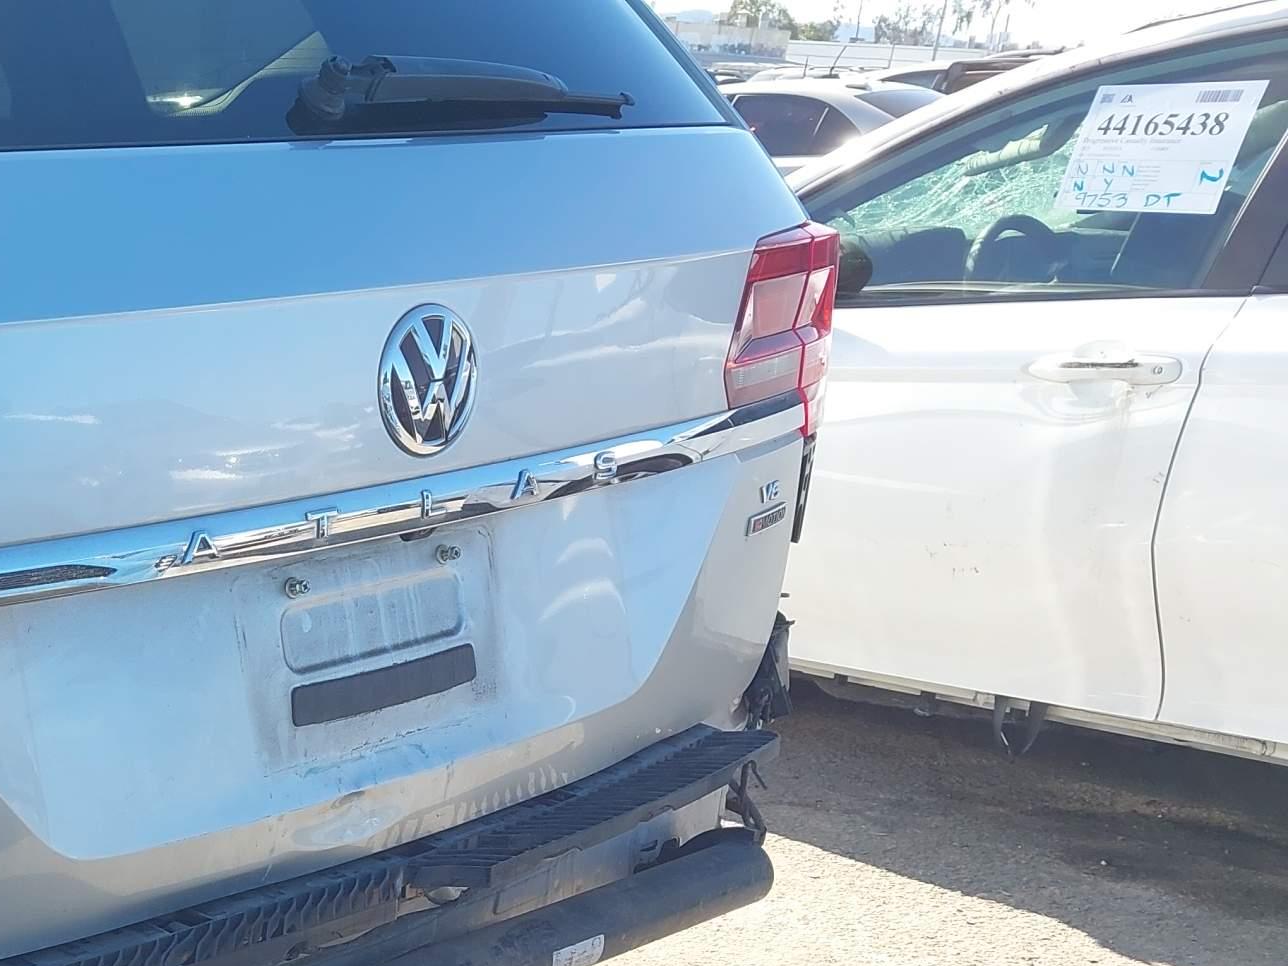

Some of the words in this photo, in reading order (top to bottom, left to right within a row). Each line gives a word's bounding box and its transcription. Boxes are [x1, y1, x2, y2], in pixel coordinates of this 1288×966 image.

[1097, 112, 1230, 136] 44165438
[1123, 164, 1135, 177] N
[1073, 180, 1084, 191] N
[1075, 192, 1128, 208] 9753
[1144, 192, 1182, 207] DT
[181, 450, 618, 565] ATLAS
